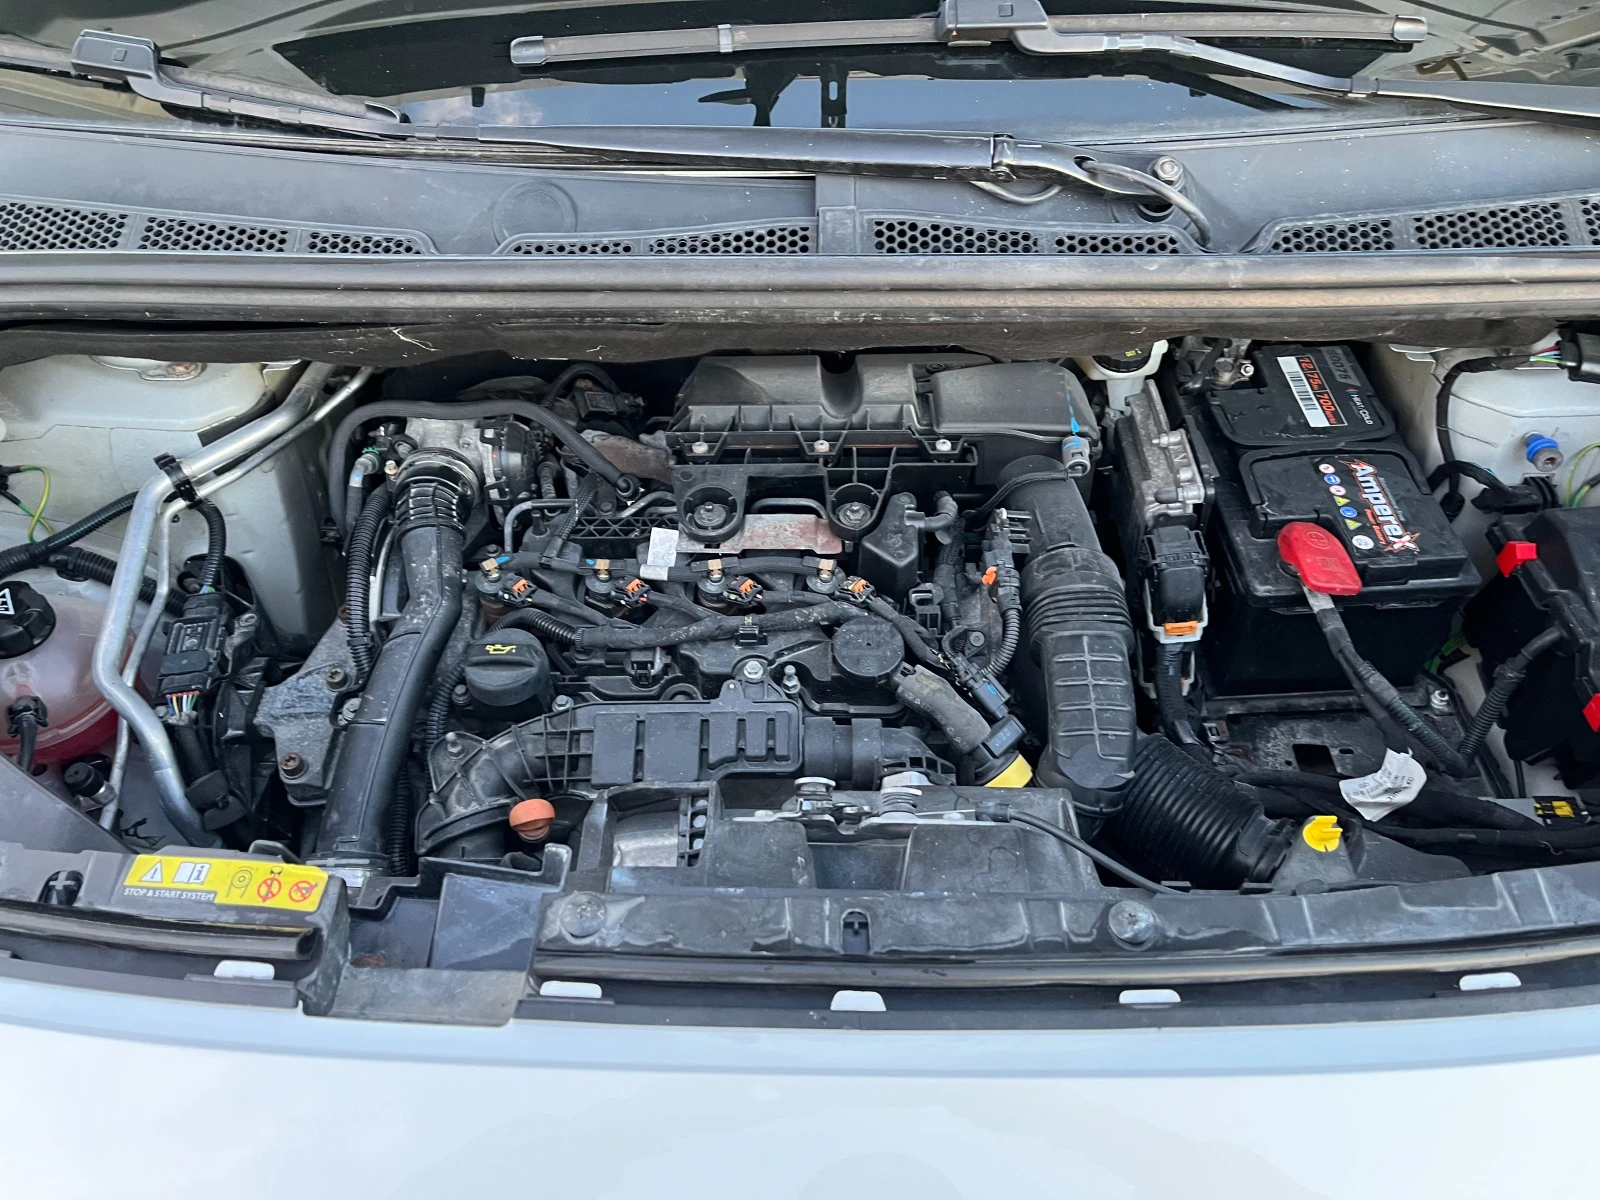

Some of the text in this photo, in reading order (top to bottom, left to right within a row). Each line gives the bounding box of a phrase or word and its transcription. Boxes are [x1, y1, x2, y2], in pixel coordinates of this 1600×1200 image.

[123, 887, 147, 897] STOP
[153, 889, 182, 899] START
[180, 891, 215, 901] SYSTEM
